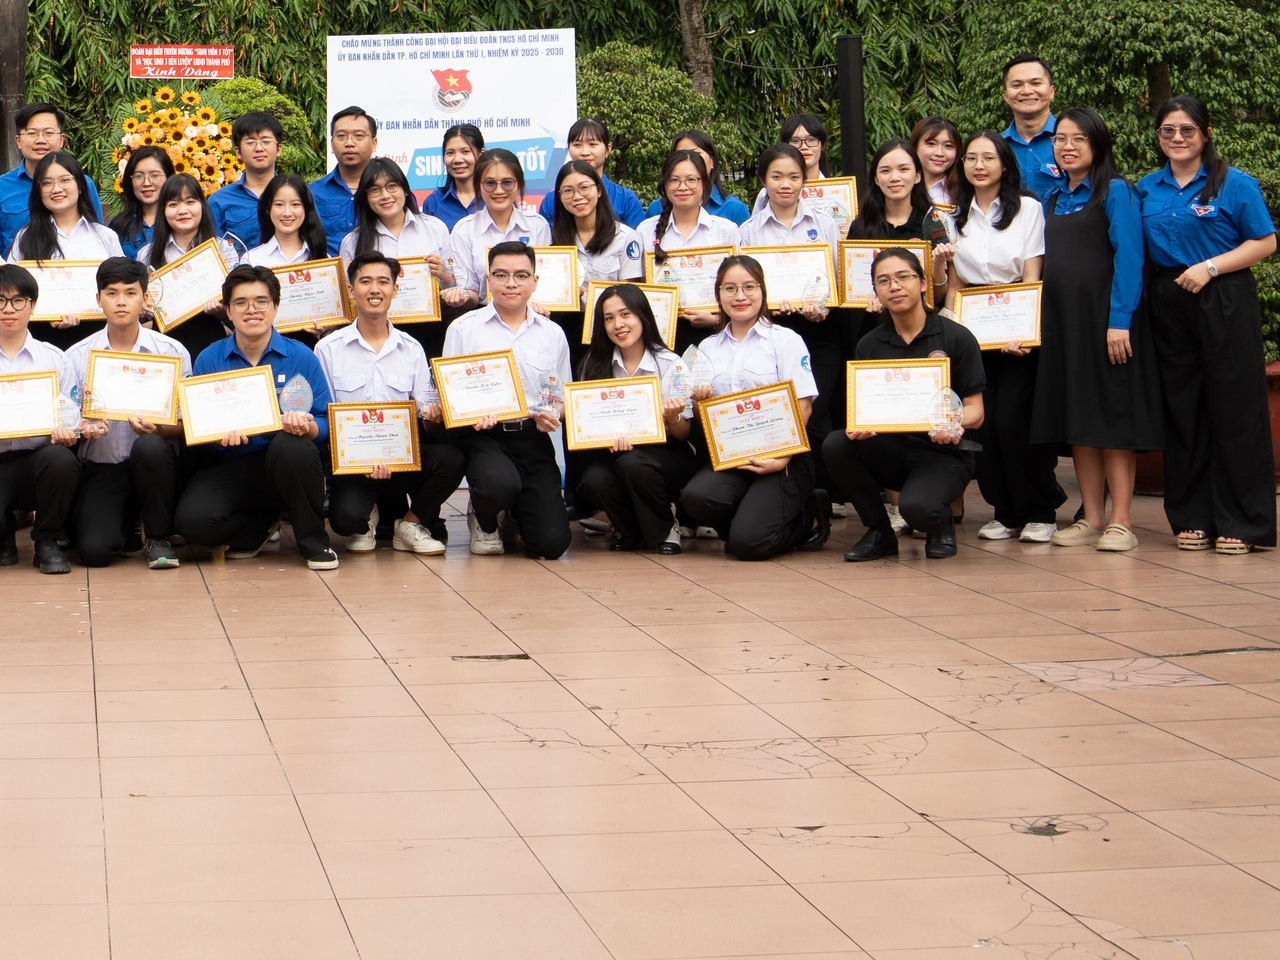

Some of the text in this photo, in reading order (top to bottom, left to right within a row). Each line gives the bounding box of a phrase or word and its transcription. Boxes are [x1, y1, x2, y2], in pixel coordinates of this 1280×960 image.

[342, 38, 359, 48] CHÀO
[383, 37, 404, 47] THÀNH
[406, 36, 423, 46] CÔNG
[425, 37, 436, 48] ĐẠI
[438, 35, 449, 47] HỘI
[451, 36, 461, 46] ĐẠI
[480, 33, 497, 44] ĐOÀN
[499, 35, 515, 44] TNCS
[528, 32, 539, 43] CHÍ
[541, 34, 560, 42] MINH
[348, 53, 360, 61] BAN
[363, 51, 380, 61] NHÂN
[382, 50, 395, 60] DÂN
[397, 52, 407, 60] TP.
[420, 49, 431, 60] CHÍ
[432, 50, 450, 59] MINH
[487, 47, 509, 60] NHIỆM
[521, 48, 539, 57] 2025
[546, 47, 564, 56] 2030
[386, 120, 401, 130] BAN
[402, 118, 422, 130] NHÂN
[424, 118, 439, 129] DÂN
[496, 116, 508, 128] CHÍ
[510, 118, 531, 128] MINH
[415, 145, 547, 176] SIN TỐT
